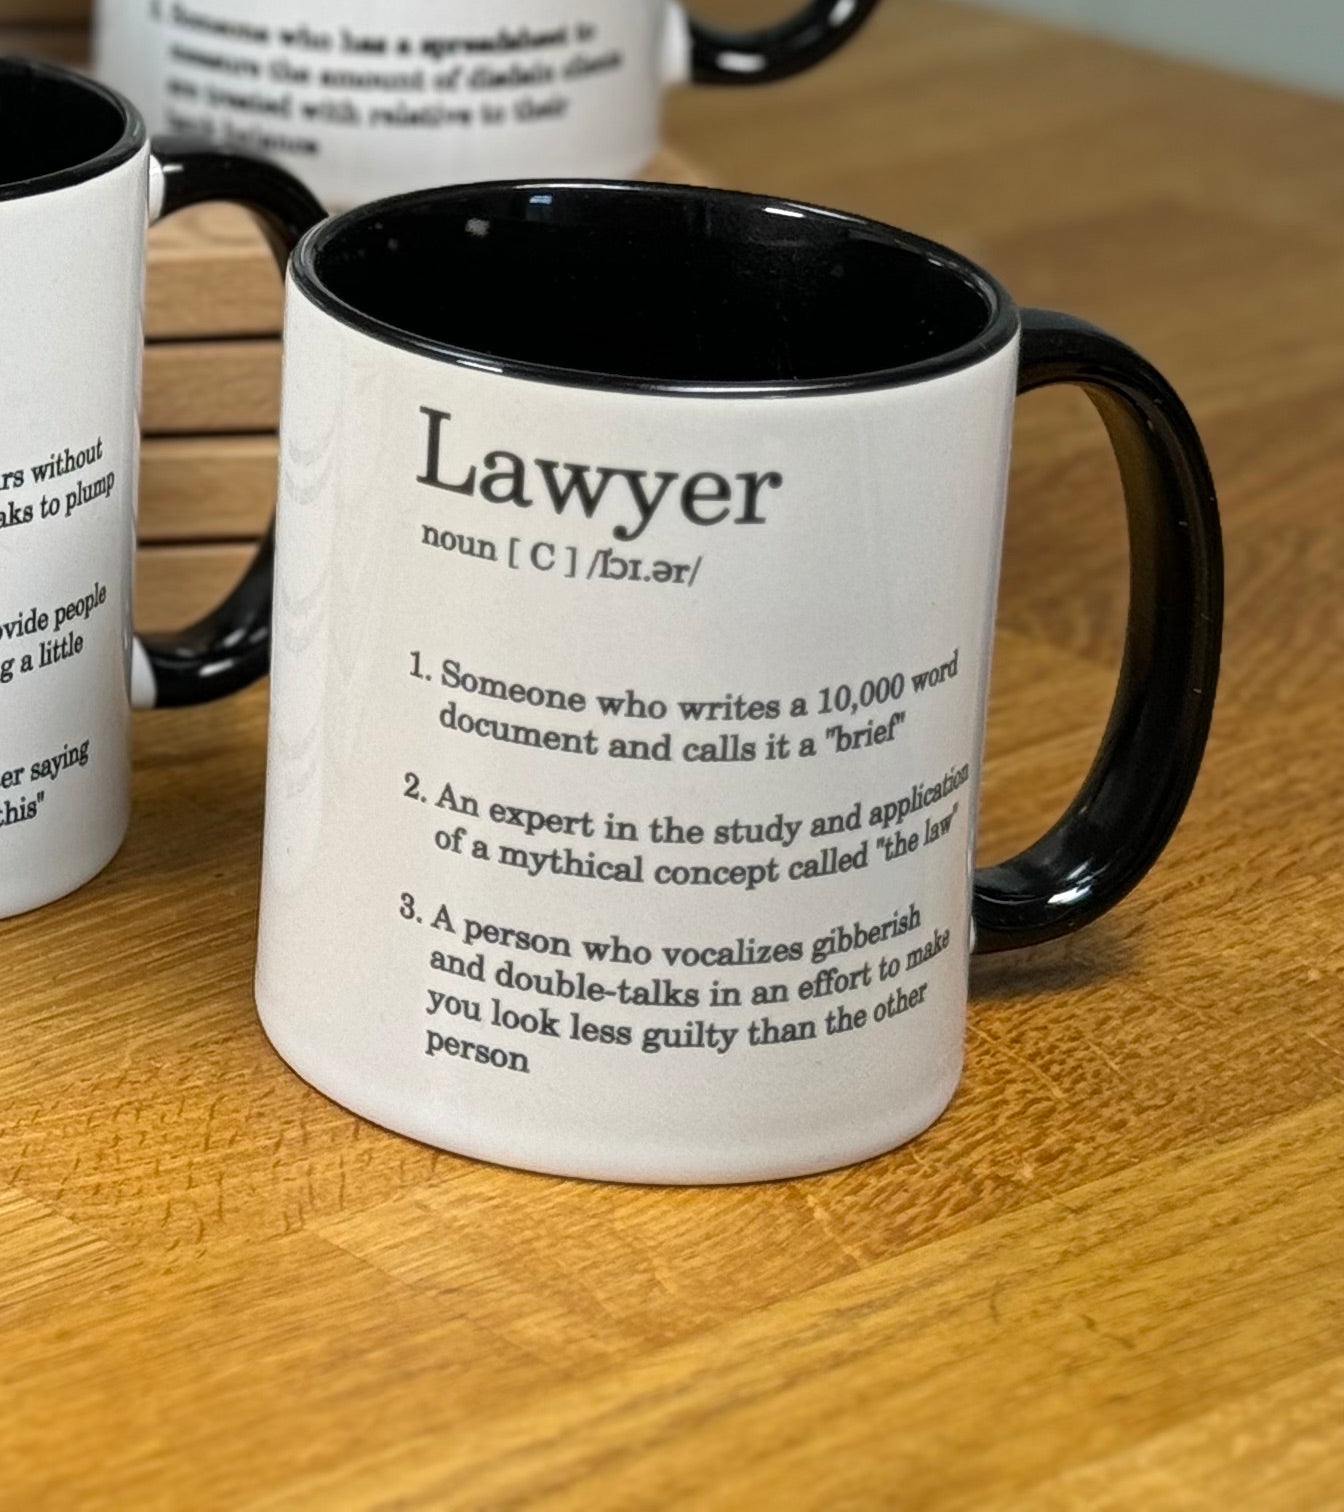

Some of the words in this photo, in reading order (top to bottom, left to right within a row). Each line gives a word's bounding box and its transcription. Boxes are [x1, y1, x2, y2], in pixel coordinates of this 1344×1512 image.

[31, 436, 104, 484] without
[416, 405, 782, 541] Lawyer
[40, 494, 60, 519] to
[65, 469, 116, 514] plump
[422, 524, 497, 561] noun
[409, 651, 431, 680] 1.
[441, 659, 586, 712] Someone
[595, 689, 667, 720] who
[678, 692, 779, 722] writes
[792, 696, 807, 717] a
[818, 672, 905, 718] 10,000
[911, 648, 959, 694] word
[30, 739, 90, 780] saying
[439, 703, 598, 755] document
[608, 730, 671, 762] and
[682, 730, 756, 763] calls
[766, 728, 789, 760] it
[799, 736, 817, 757] a
[826, 711, 906, 754] "brief"
[403, 772, 426, 803] 2.
[435, 781, 479, 818] An
[489, 801, 594, 838] expert
[605, 813, 637, 840] in
[648, 816, 704, 844] the
[714, 815, 802, 847] study
[809, 802, 861, 837] and
[869, 761, 969, 834] application
[434, 827, 467, 855] of
[473, 840, 490, 860] a
[499, 844, 643, 883] mythical
[654, 858, 778, 890] concept
[788, 845, 868, 880] called
[876, 832, 919, 862] "the
[923, 802, 959, 848] law"
